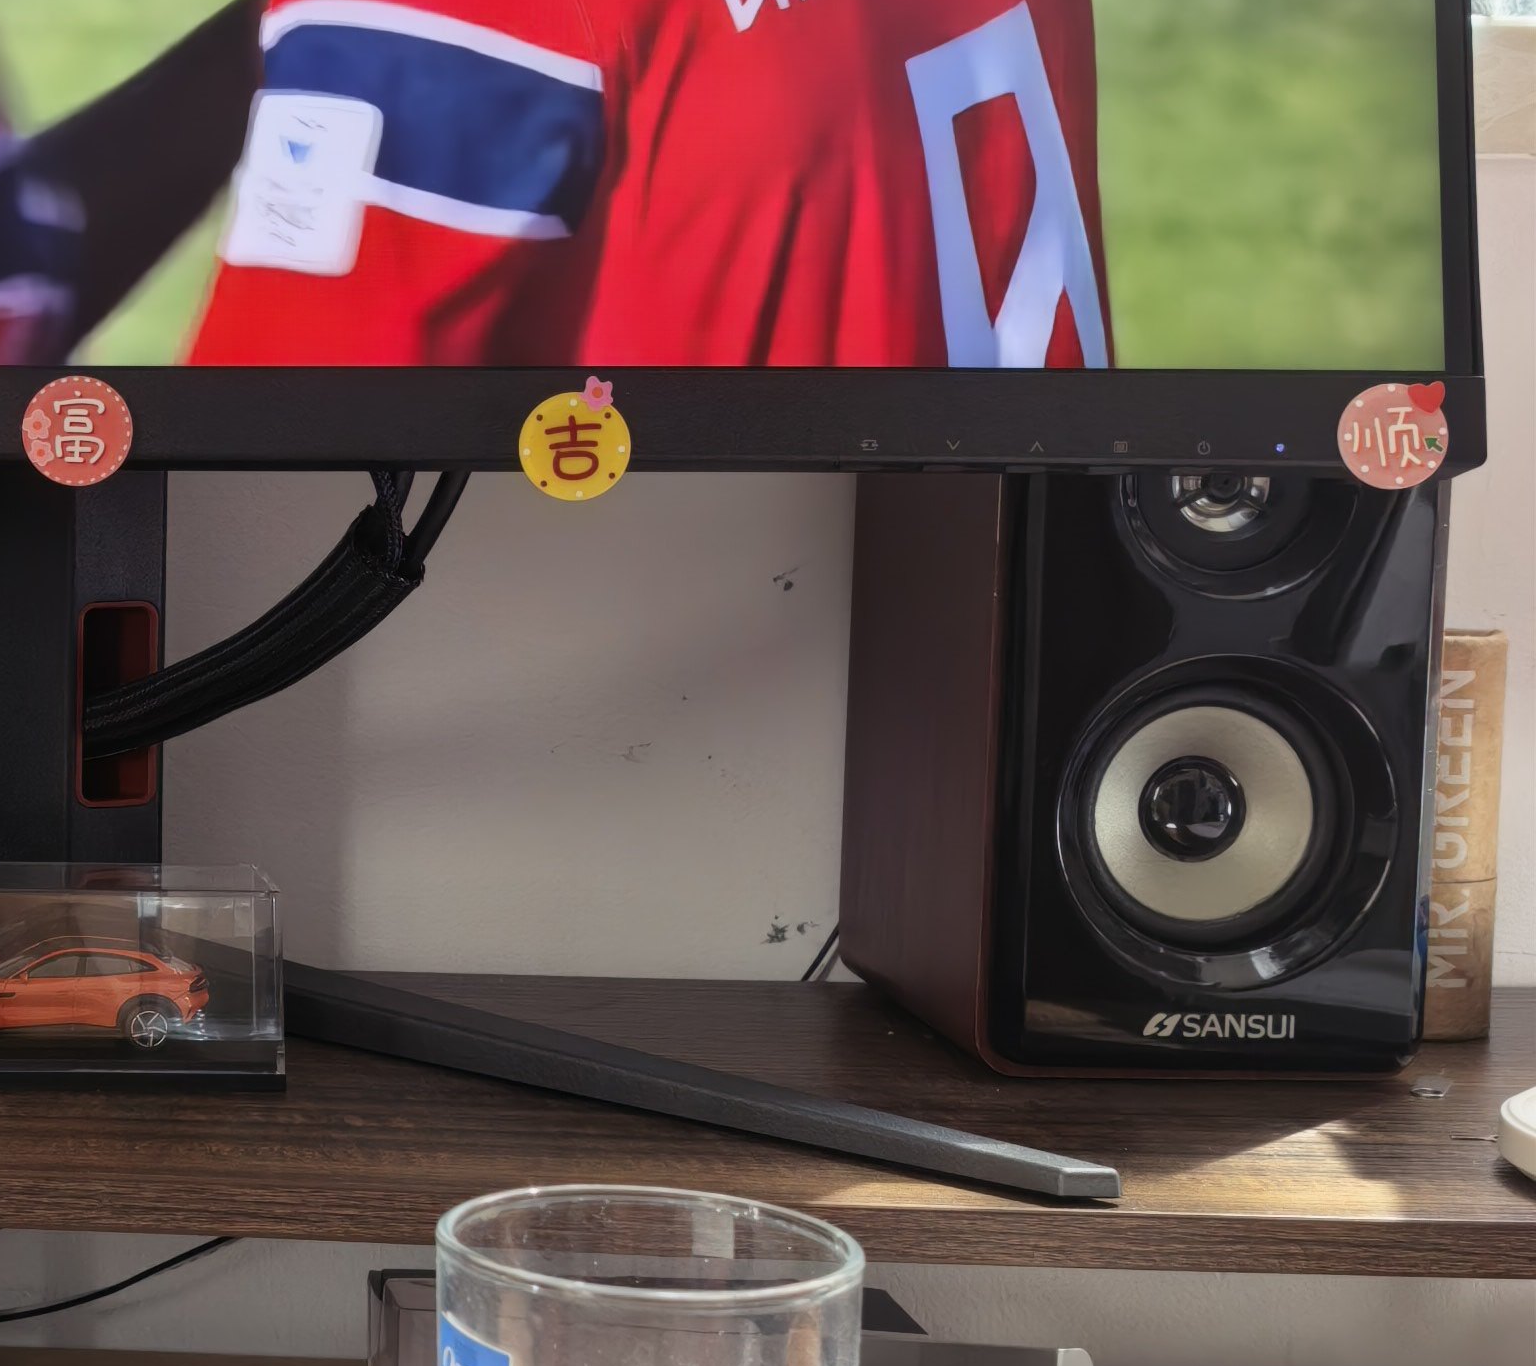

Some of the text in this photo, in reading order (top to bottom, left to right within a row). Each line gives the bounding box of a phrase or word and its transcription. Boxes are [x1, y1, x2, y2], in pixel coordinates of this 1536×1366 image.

[53, 390, 106, 464] 富
[545, 414, 601, 480] 吉
[1351, 406, 1421, 467] 顺
[1181, 1011, 1296, 1040] SANSUI
